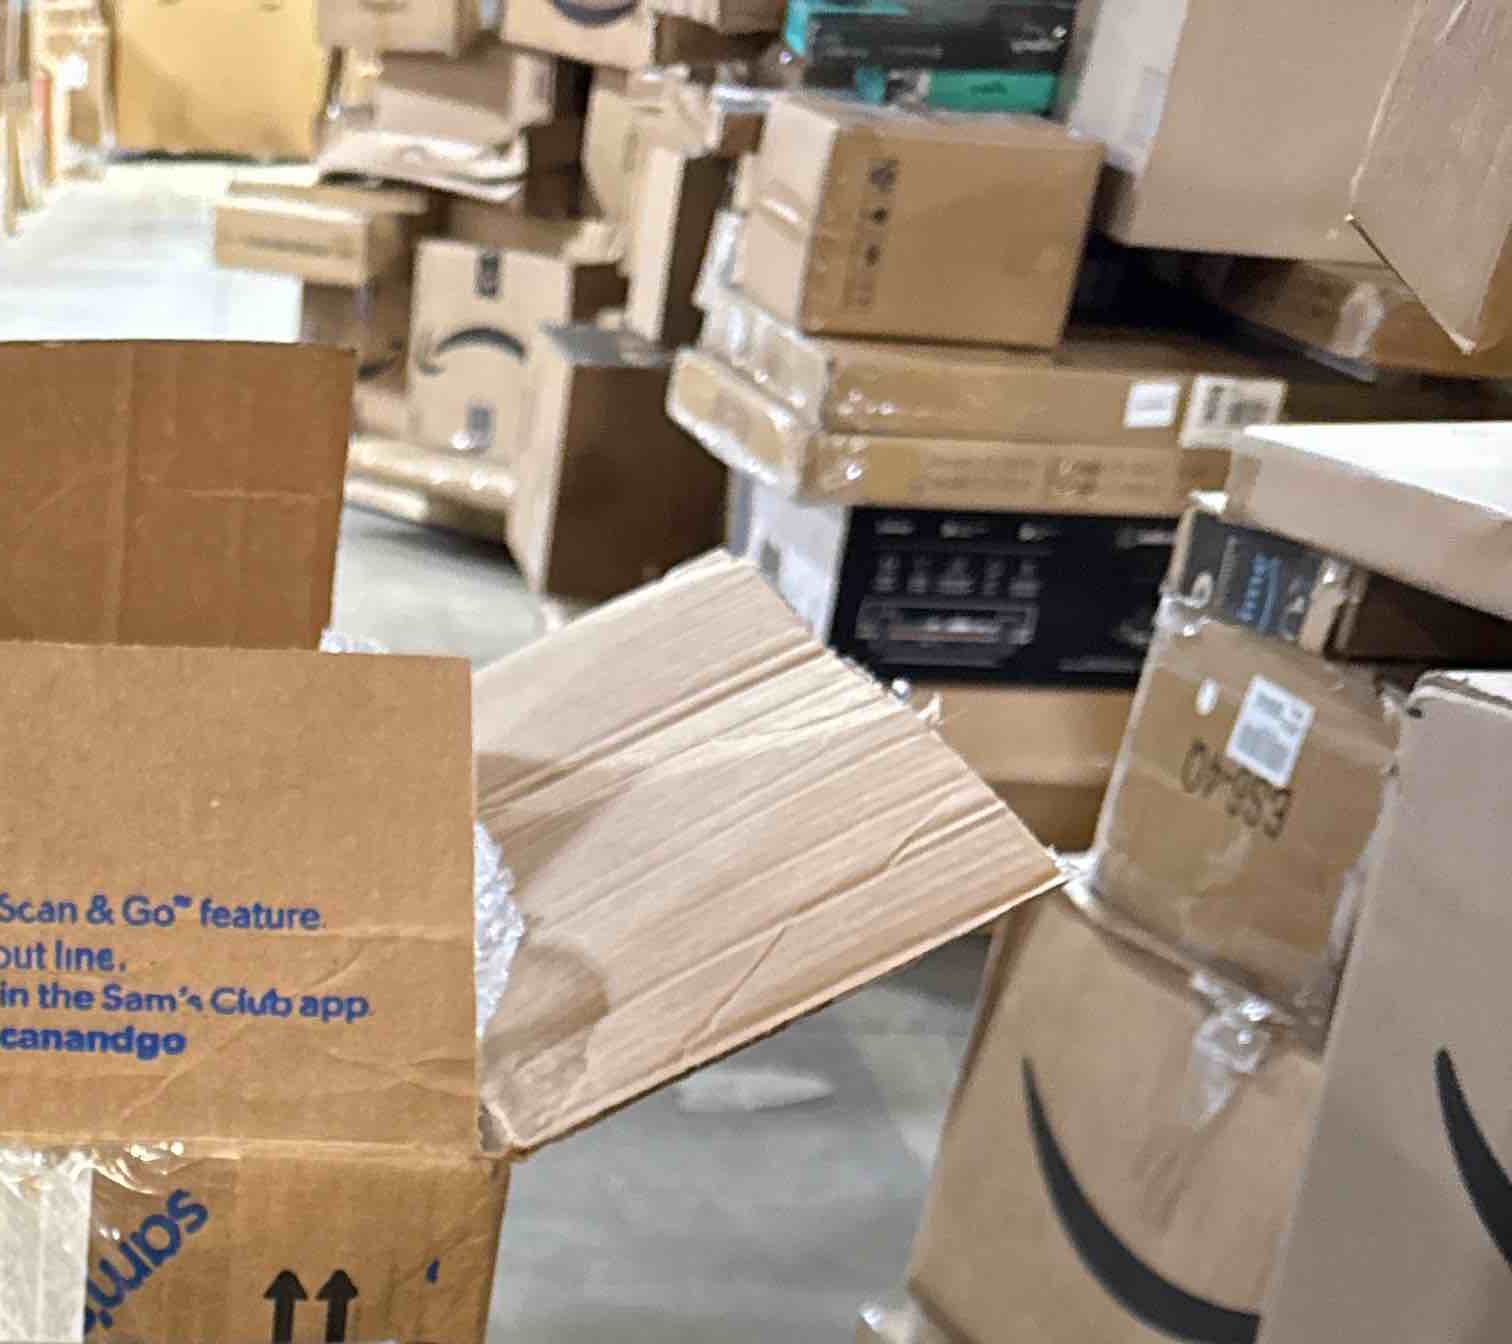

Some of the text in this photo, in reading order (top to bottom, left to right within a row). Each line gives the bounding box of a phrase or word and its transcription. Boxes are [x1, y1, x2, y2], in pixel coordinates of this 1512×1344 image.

[85, 893, 115, 926] &
[55, 938, 127, 972] line.
[37, 983, 94, 1011] the
[101, 984, 204, 1013] Sam's
[210, 987, 292, 1018] Club
